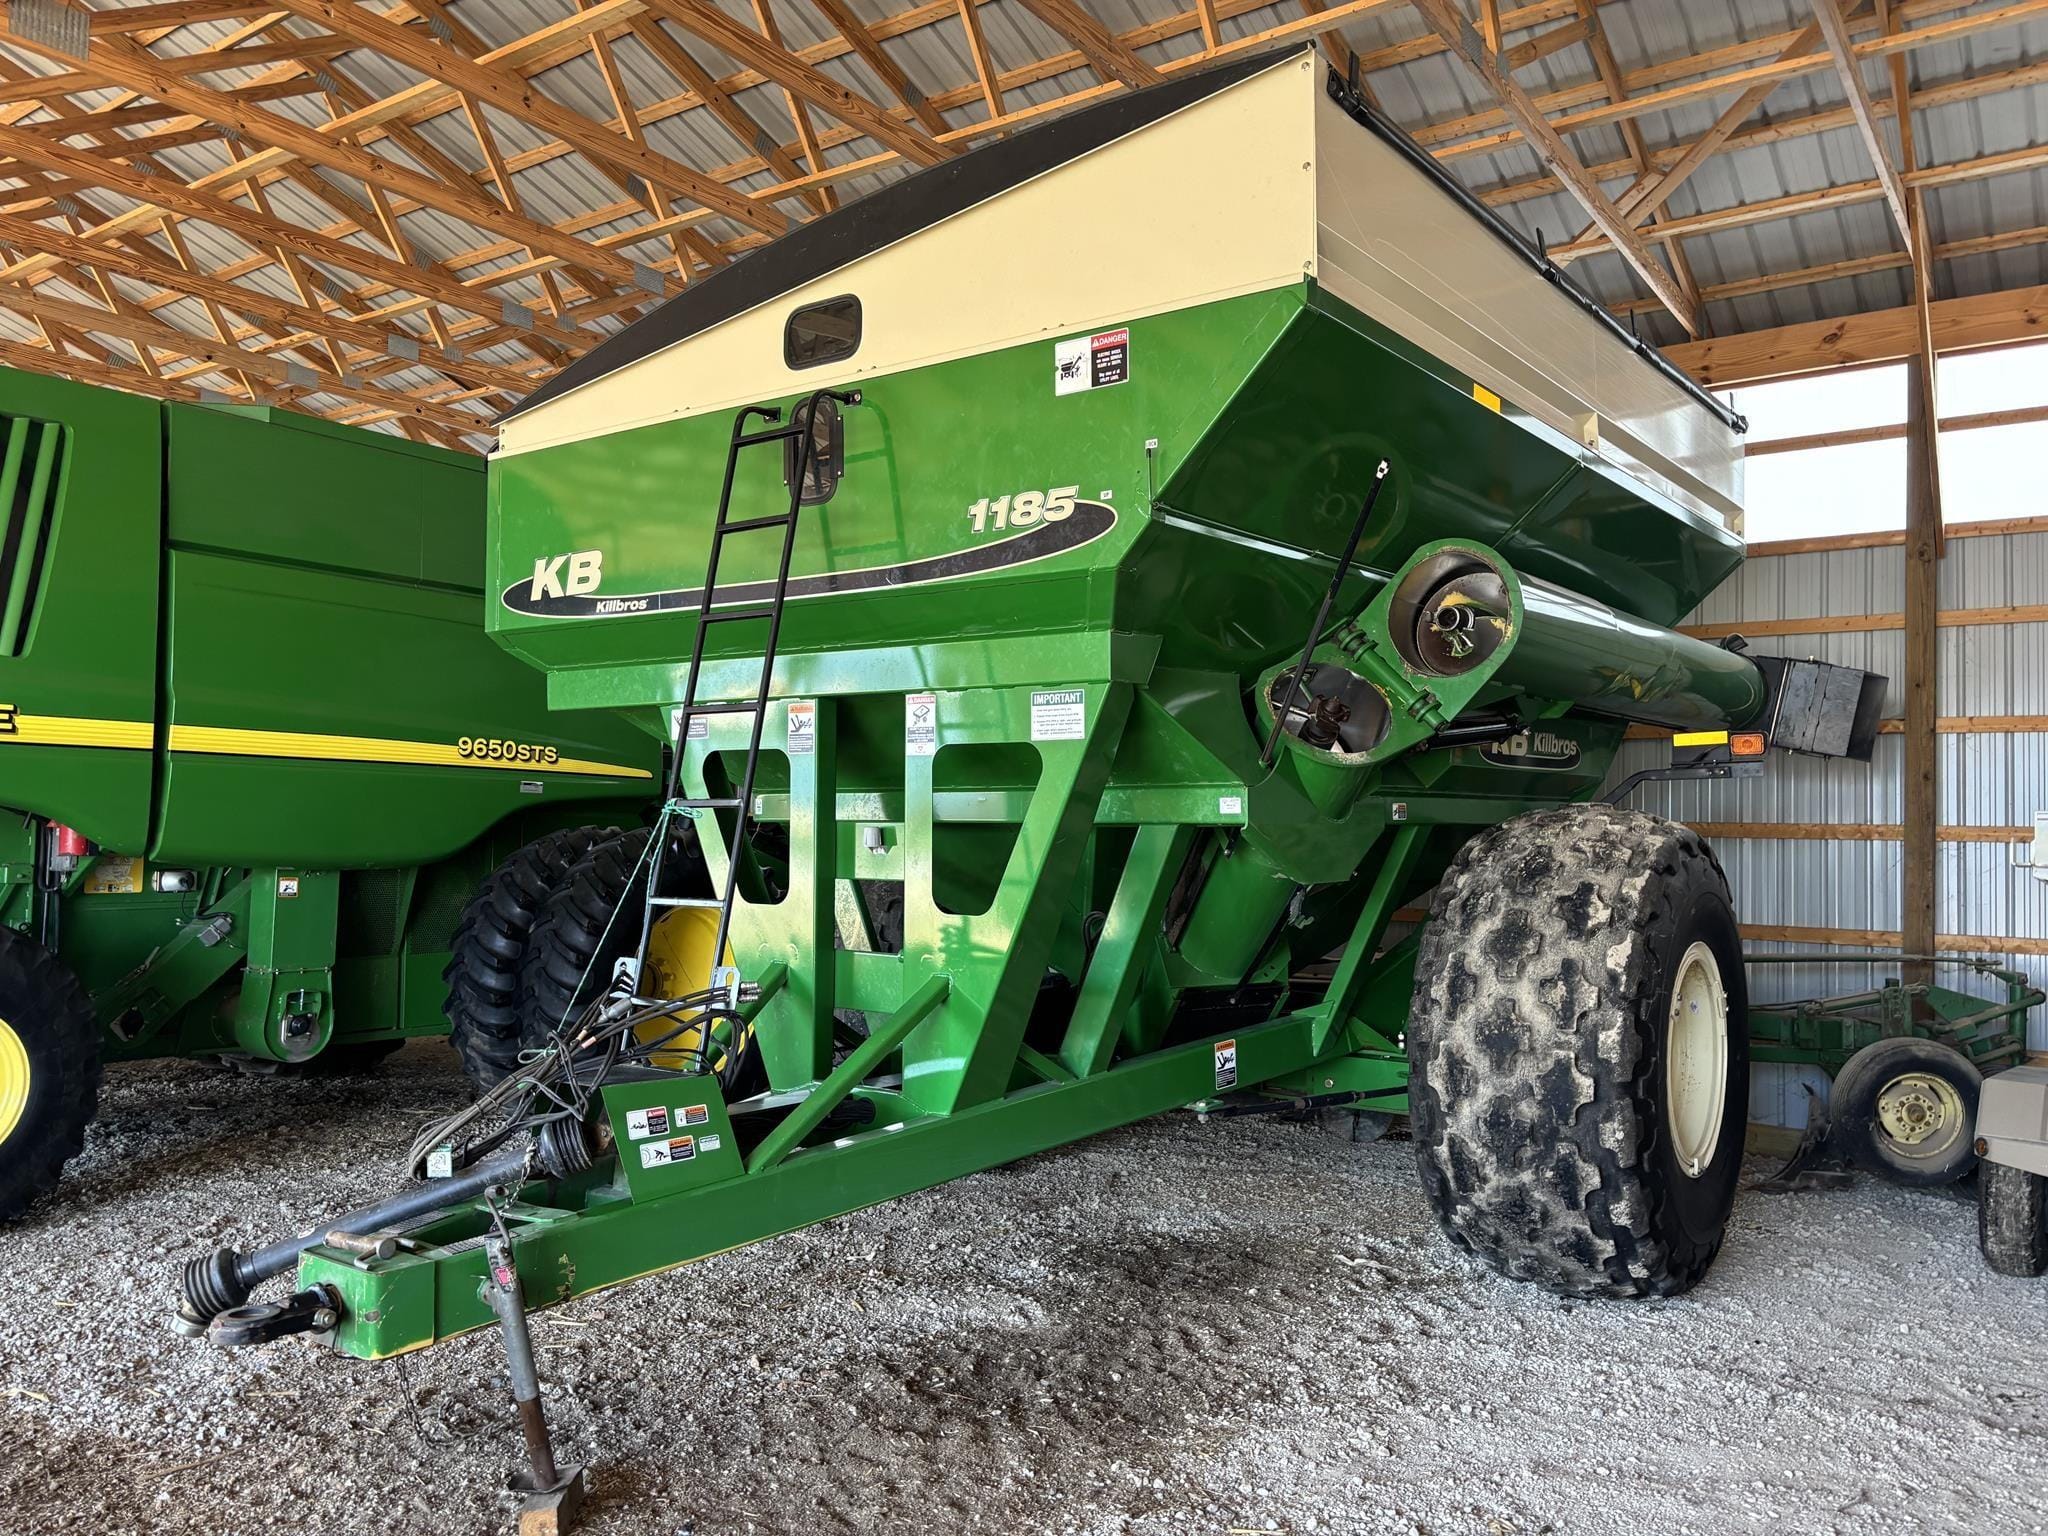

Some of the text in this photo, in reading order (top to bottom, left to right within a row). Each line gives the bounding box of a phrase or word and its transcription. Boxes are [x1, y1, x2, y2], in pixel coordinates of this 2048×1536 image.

[1099, 333, 1128, 345] DANGER
[967, 485, 1079, 533] 1185
[530, 549, 603, 601] KB
[595, 599, 648, 613] Killbros
[1033, 692, 1082, 705] IMPORTANT
[458, 736, 559, 764] 9650STS
[1533, 732, 1578, 756] Killbros
